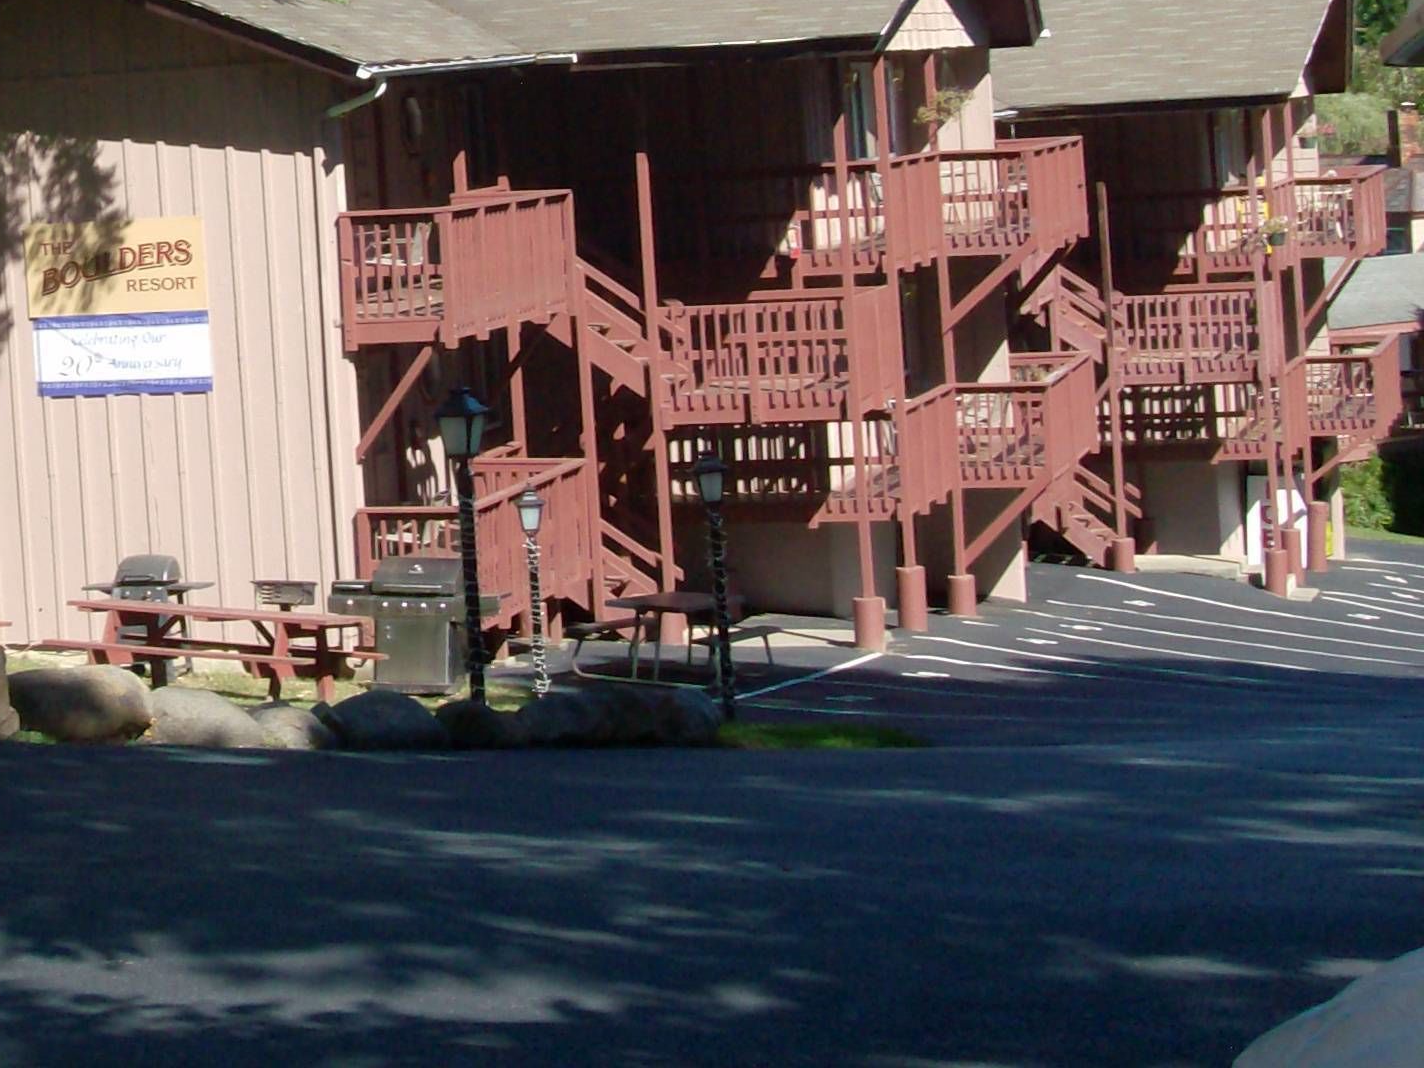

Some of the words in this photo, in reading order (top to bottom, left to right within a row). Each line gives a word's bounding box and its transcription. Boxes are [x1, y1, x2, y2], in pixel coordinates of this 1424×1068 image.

[40, 241, 73, 256] THE
[41, 239, 193, 296] BOULDERS
[126, 276, 198, 293] RESORT
